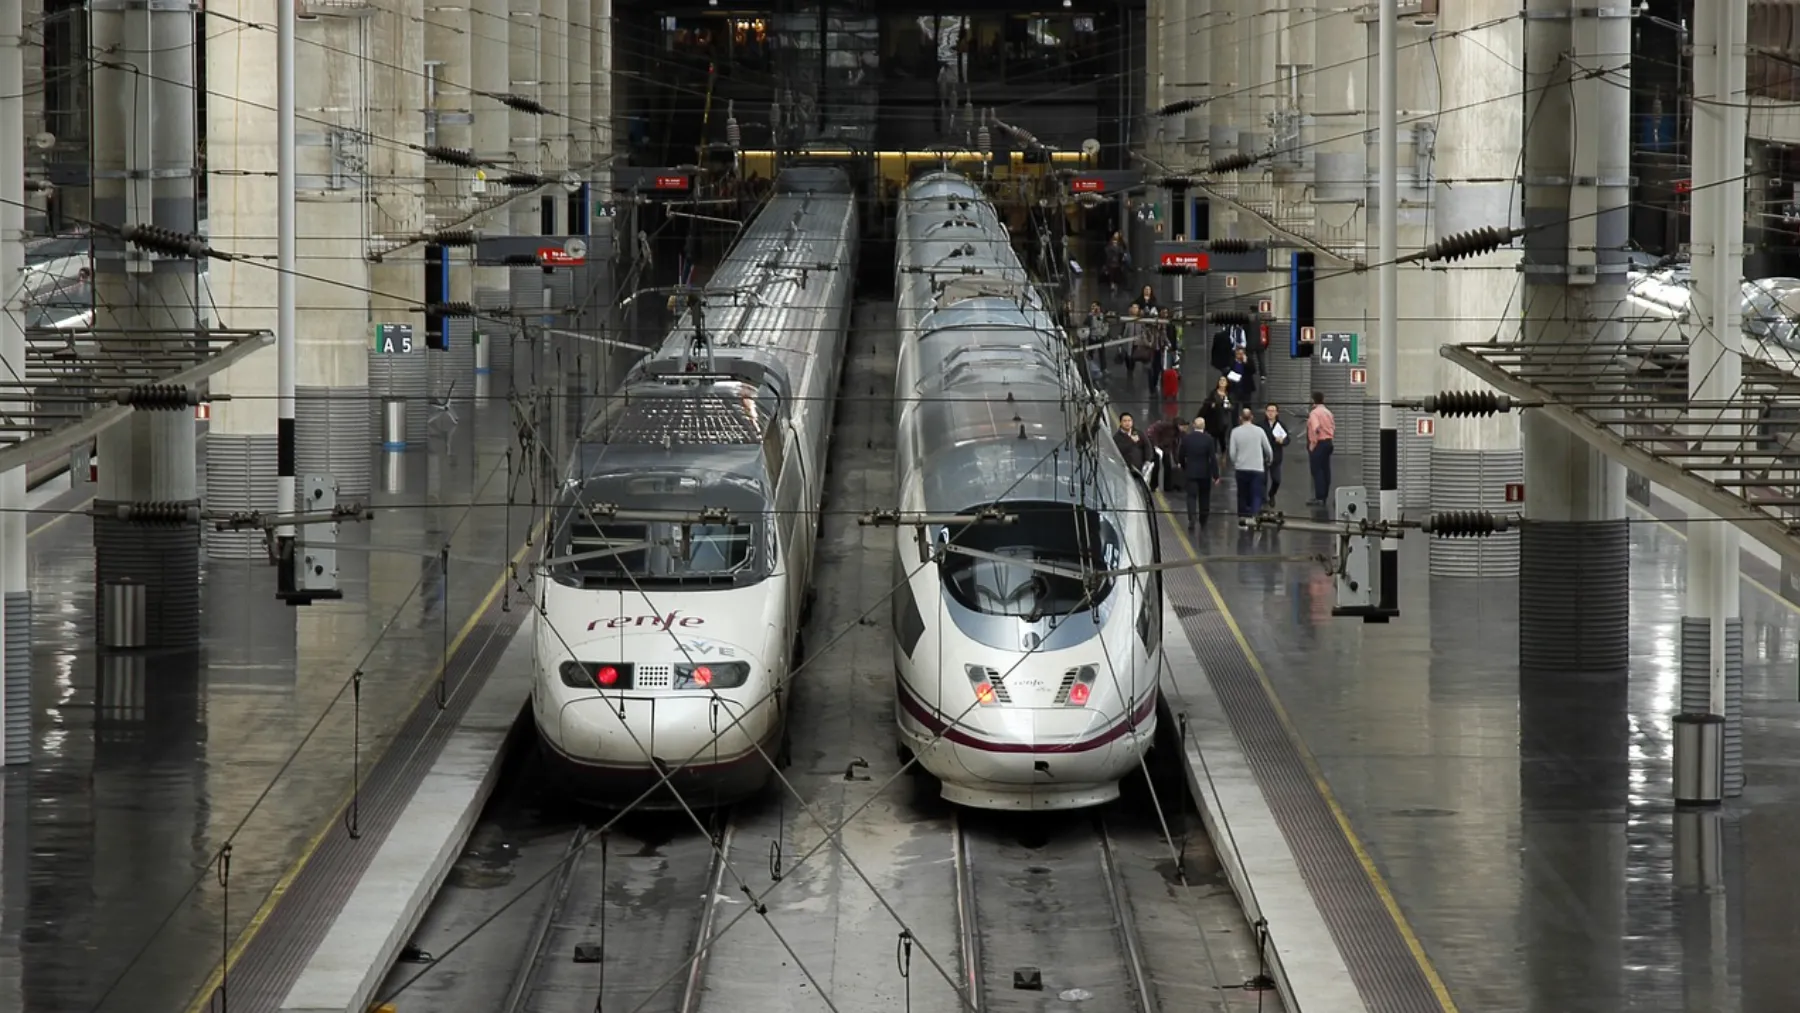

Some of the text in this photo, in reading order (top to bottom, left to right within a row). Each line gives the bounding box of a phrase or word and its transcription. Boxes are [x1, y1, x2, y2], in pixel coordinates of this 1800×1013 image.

[600, 208, 607, 216] A
[384, 338, 411, 353] A 5
[1322, 347, 1350, 362] 4 A
[587, 610, 705, 632] renfe
[674, 640, 735, 657] AVE
